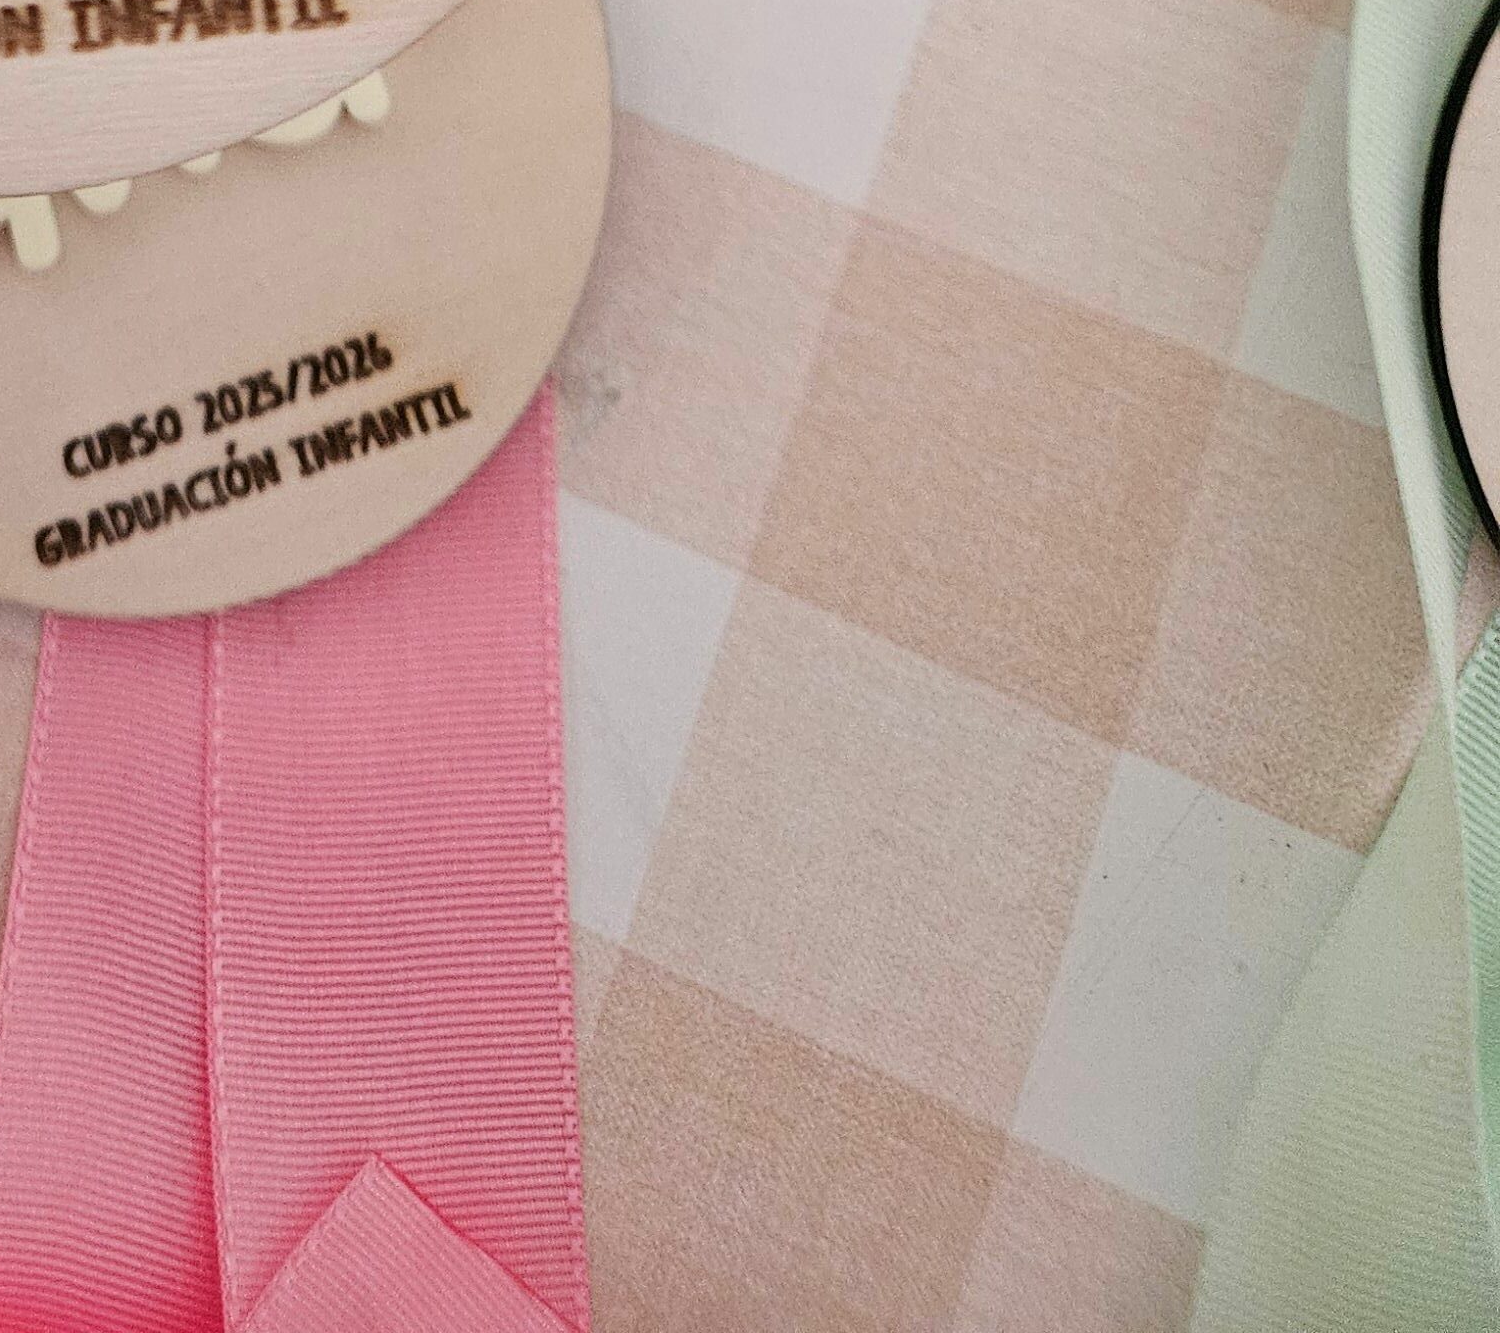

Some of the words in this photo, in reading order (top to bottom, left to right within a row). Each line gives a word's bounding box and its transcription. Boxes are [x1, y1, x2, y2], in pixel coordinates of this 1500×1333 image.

[33, 439, 282, 568] GRADUACIÓN
[288, 381, 473, 478] INFANTIL
[61, 405, 184, 478] CURSO
[195, 331, 394, 435] 2025/2026
